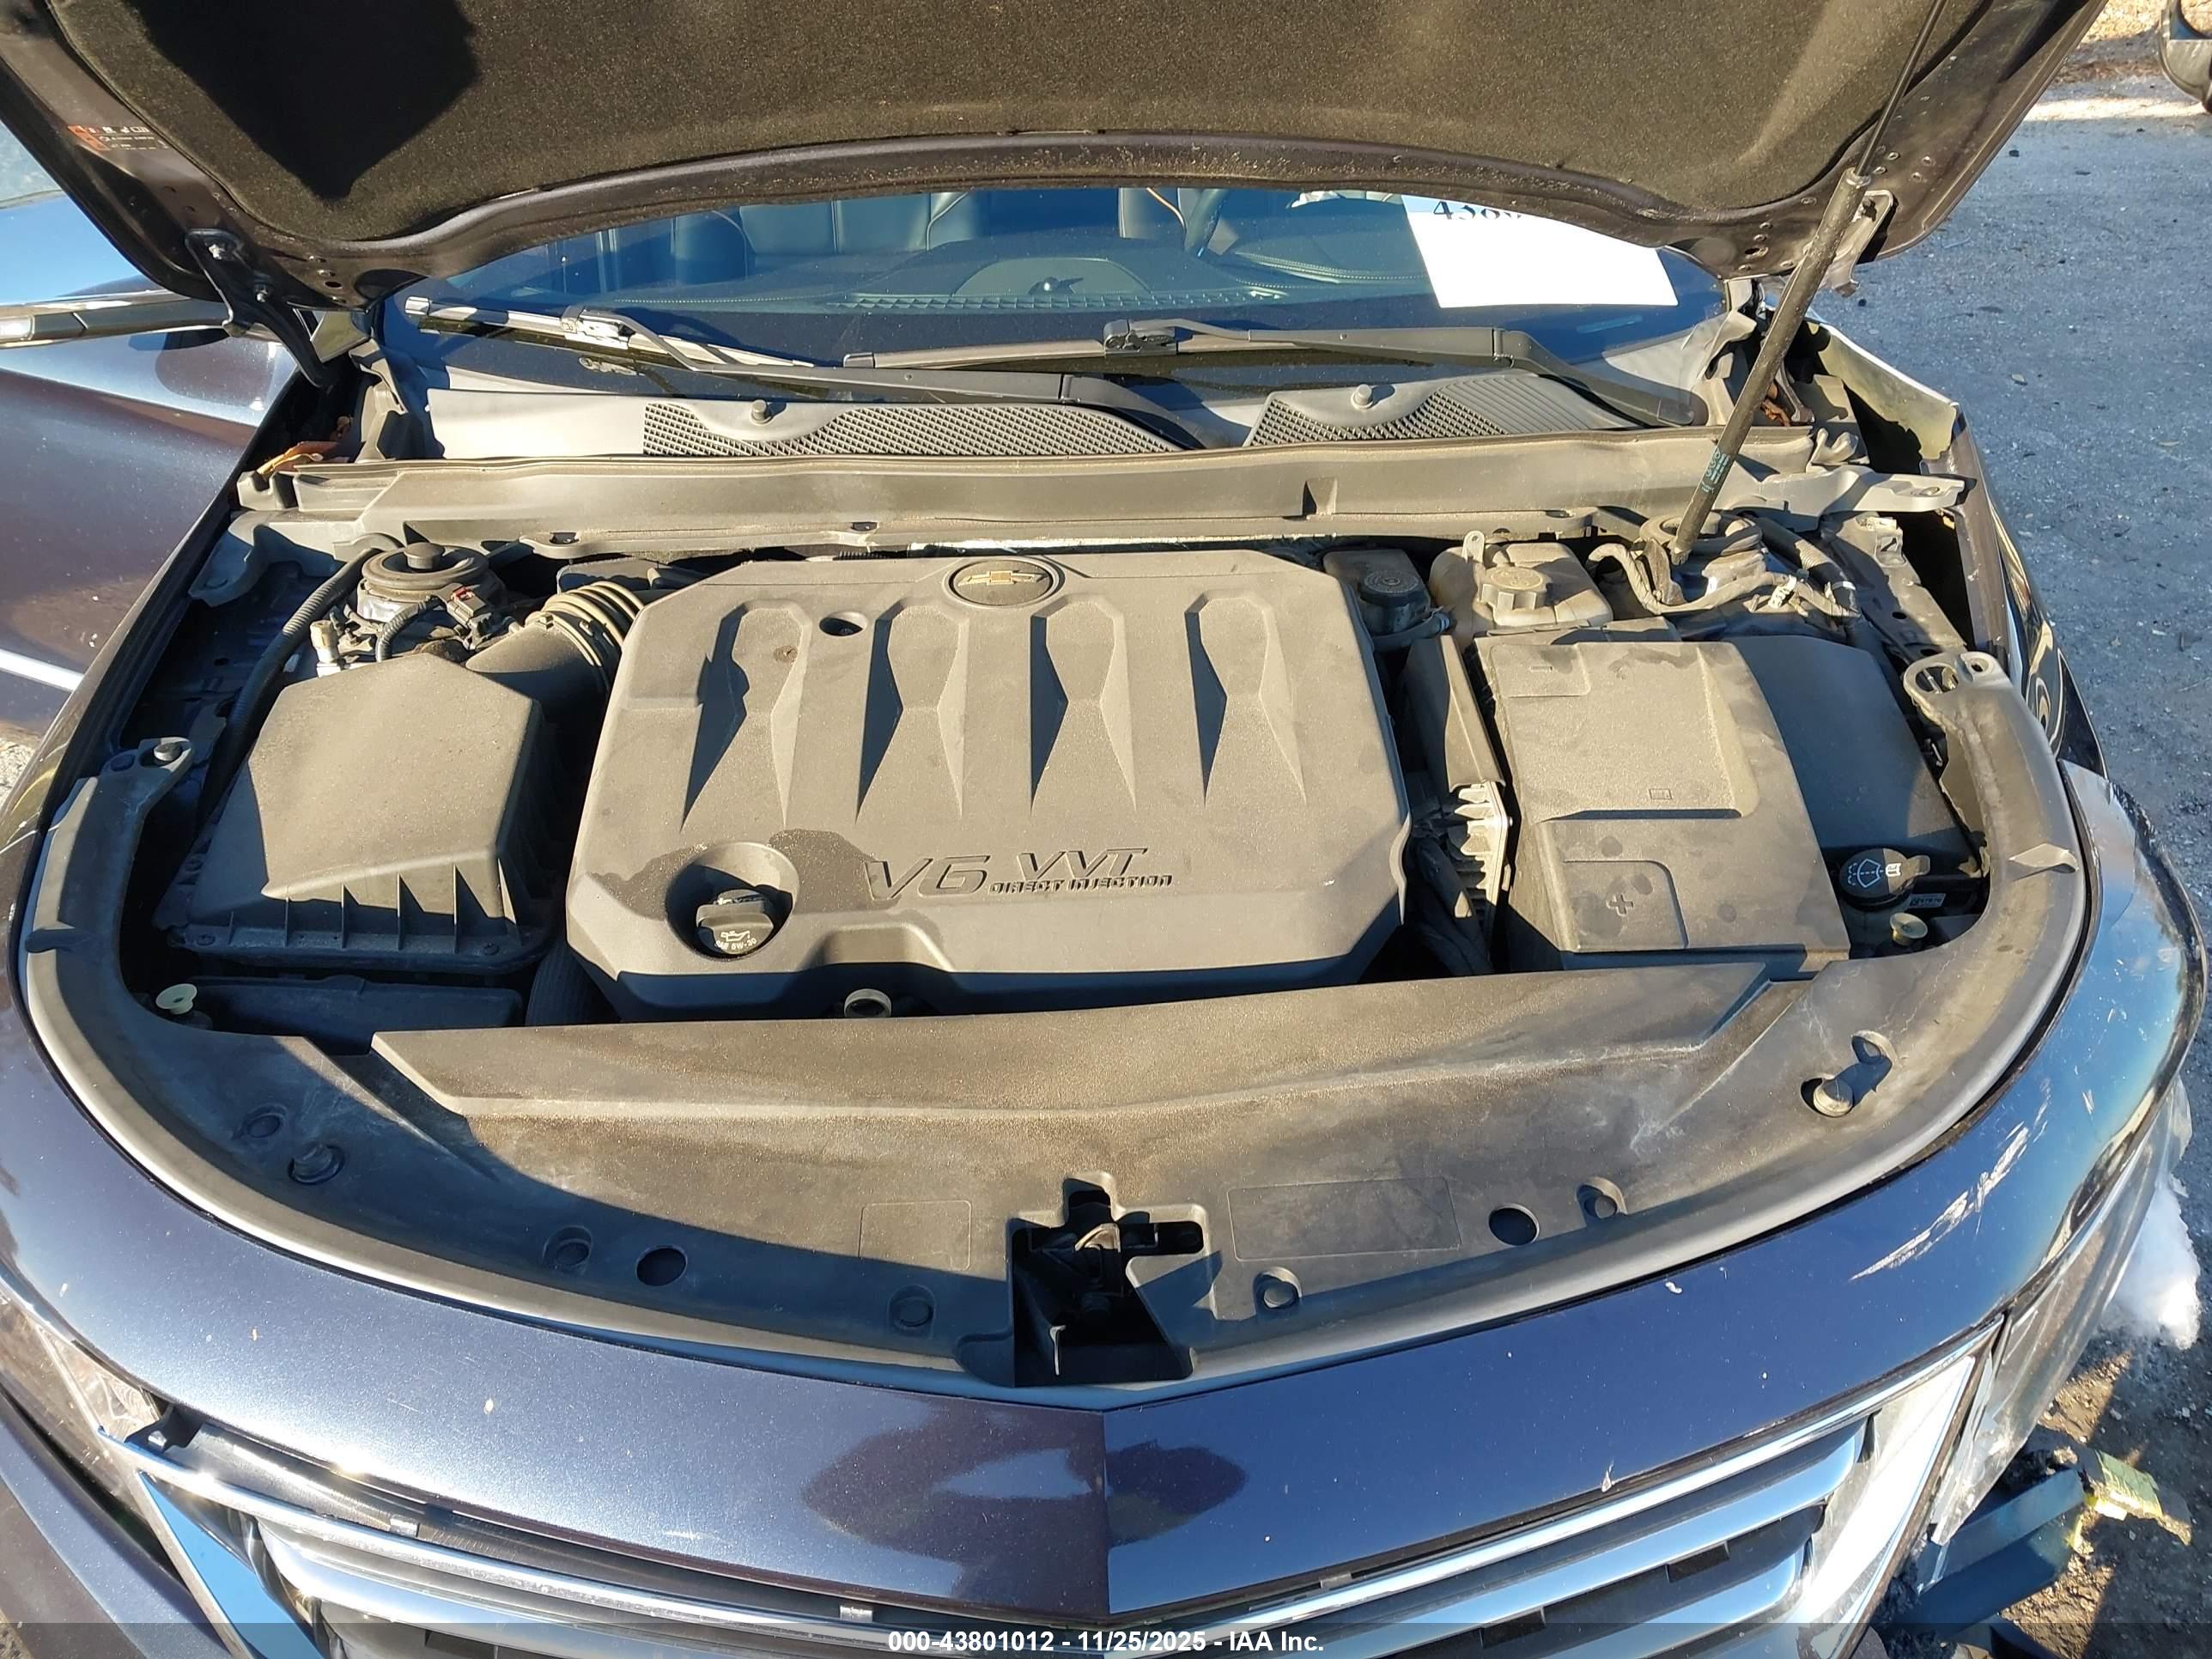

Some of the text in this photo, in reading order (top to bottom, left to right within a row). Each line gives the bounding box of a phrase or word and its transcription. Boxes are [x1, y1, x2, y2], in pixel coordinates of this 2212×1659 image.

[863, 847, 1148, 901] V6 VVT
[990, 874, 1173, 894] DIRECT INJECTION
